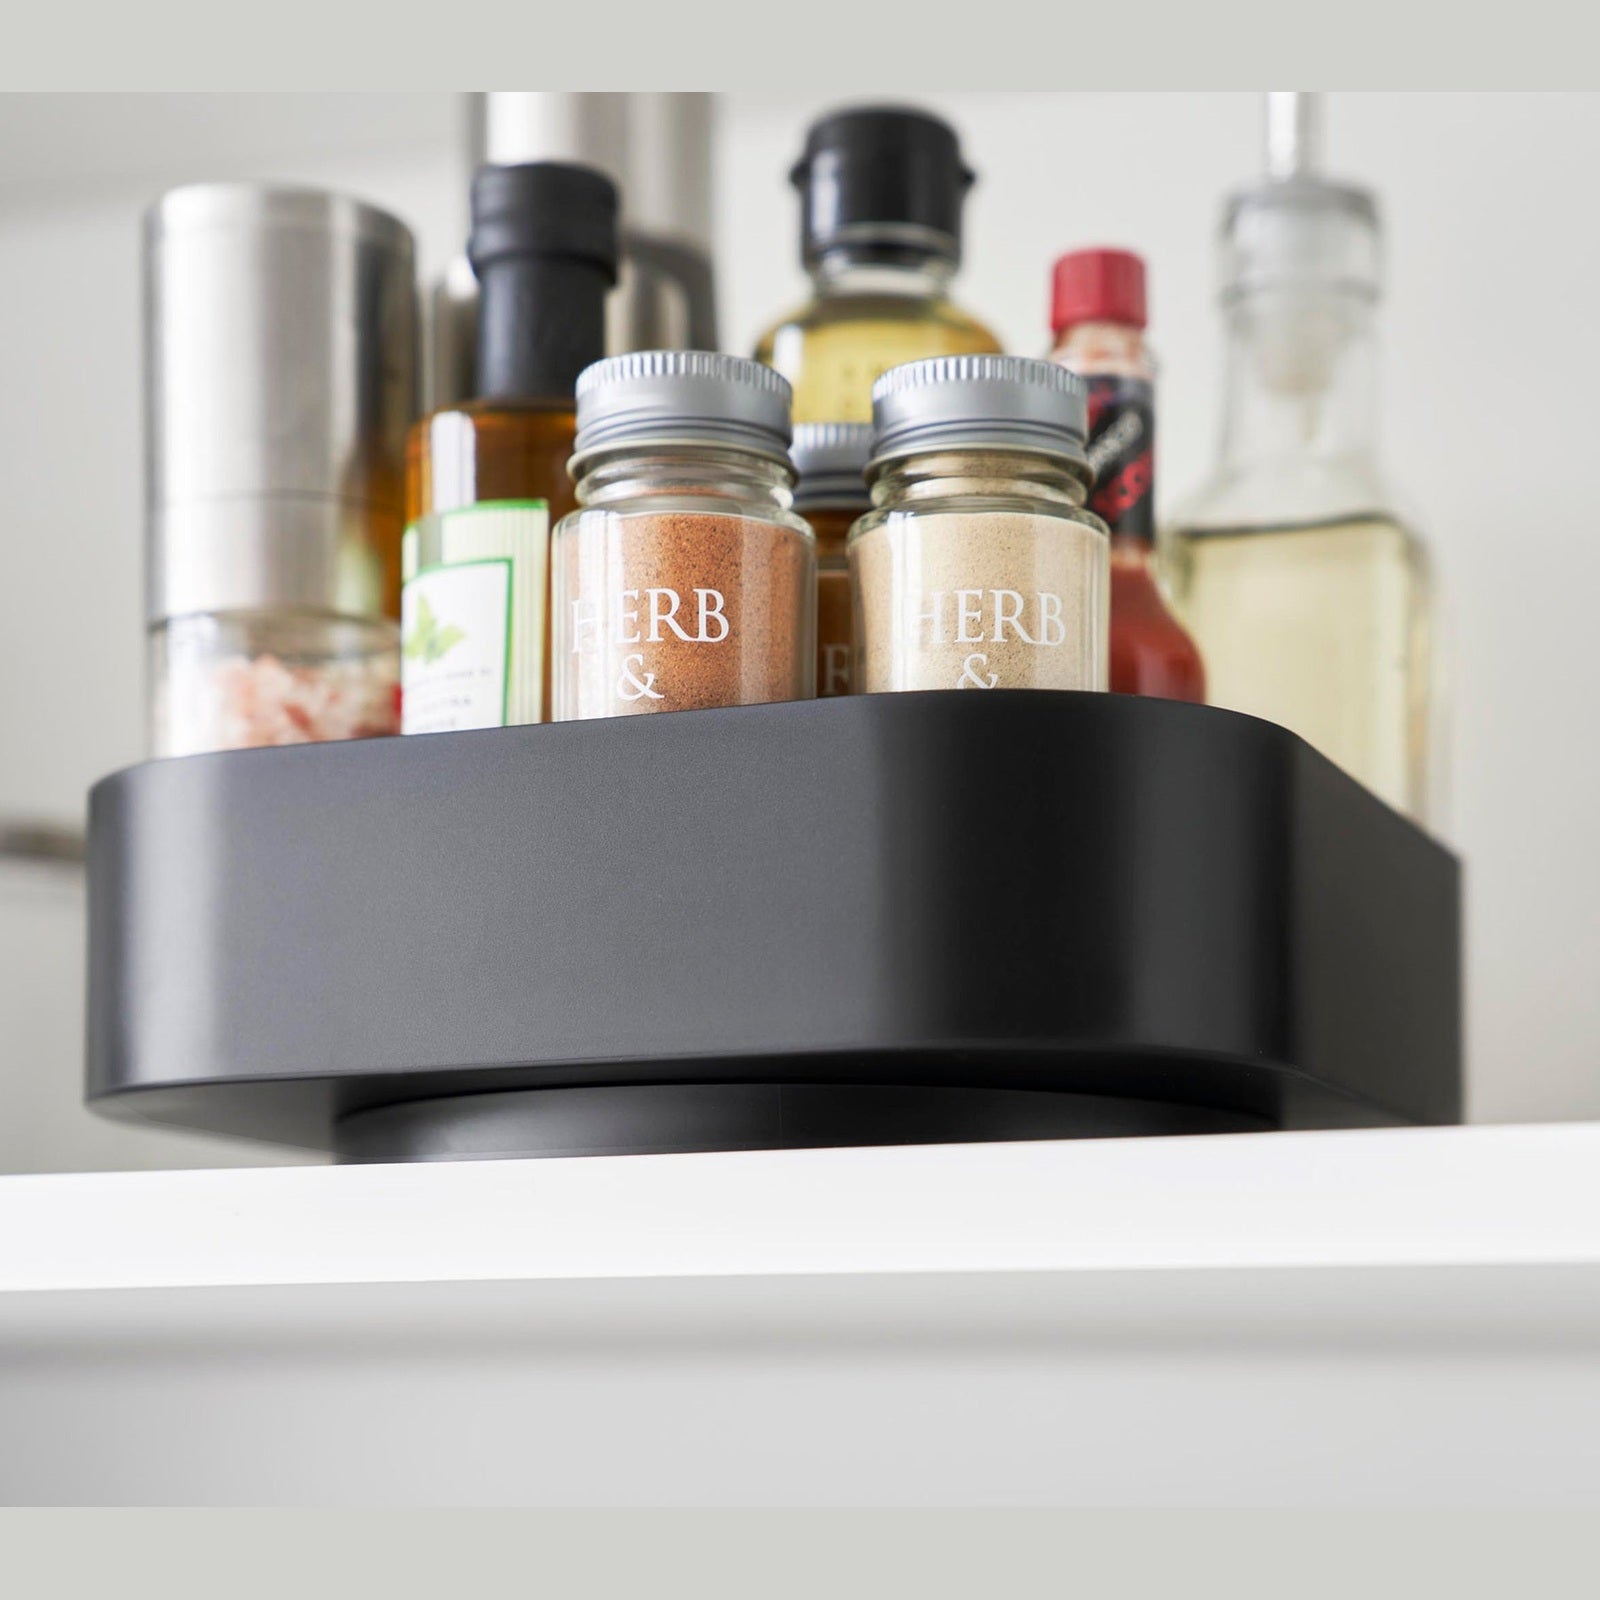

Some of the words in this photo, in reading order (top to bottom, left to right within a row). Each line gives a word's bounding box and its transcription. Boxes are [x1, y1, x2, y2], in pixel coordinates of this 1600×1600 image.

[571, 587, 730, 653] HERB
[904, 588, 1067, 647] HERB
[615, 653, 665, 701] &
[955, 653, 999, 689] &
